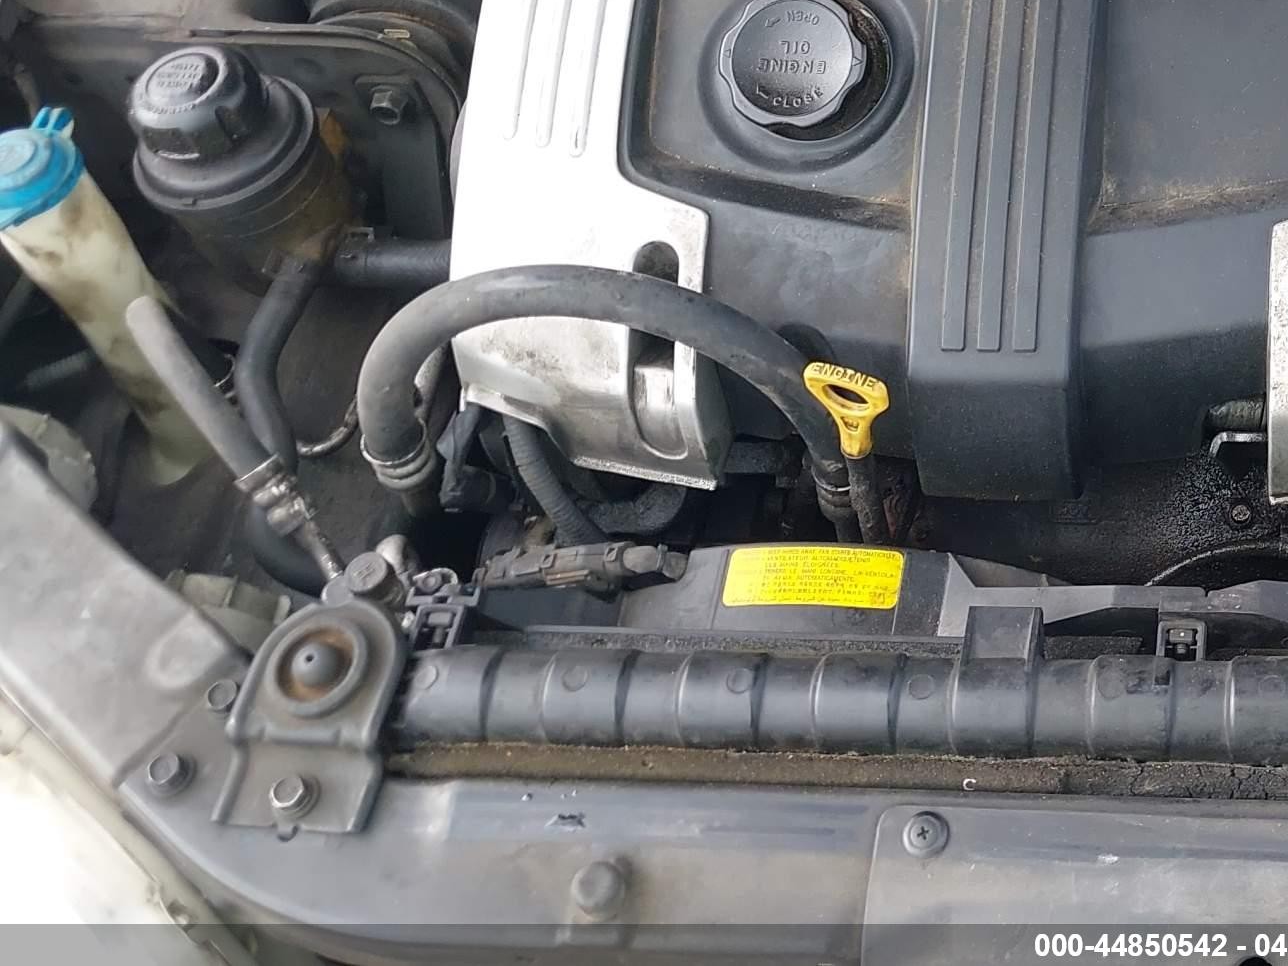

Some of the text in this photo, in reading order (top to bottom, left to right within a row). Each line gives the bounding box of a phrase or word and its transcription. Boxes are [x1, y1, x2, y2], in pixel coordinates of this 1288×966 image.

[787, 11, 820, 25] OPEN
[781, 40, 811, 54] OIL
[758, 58, 826, 74] ENGINE
[773, 87, 824, 108] CLOSE
[811, 361, 877, 389] ENGINE
